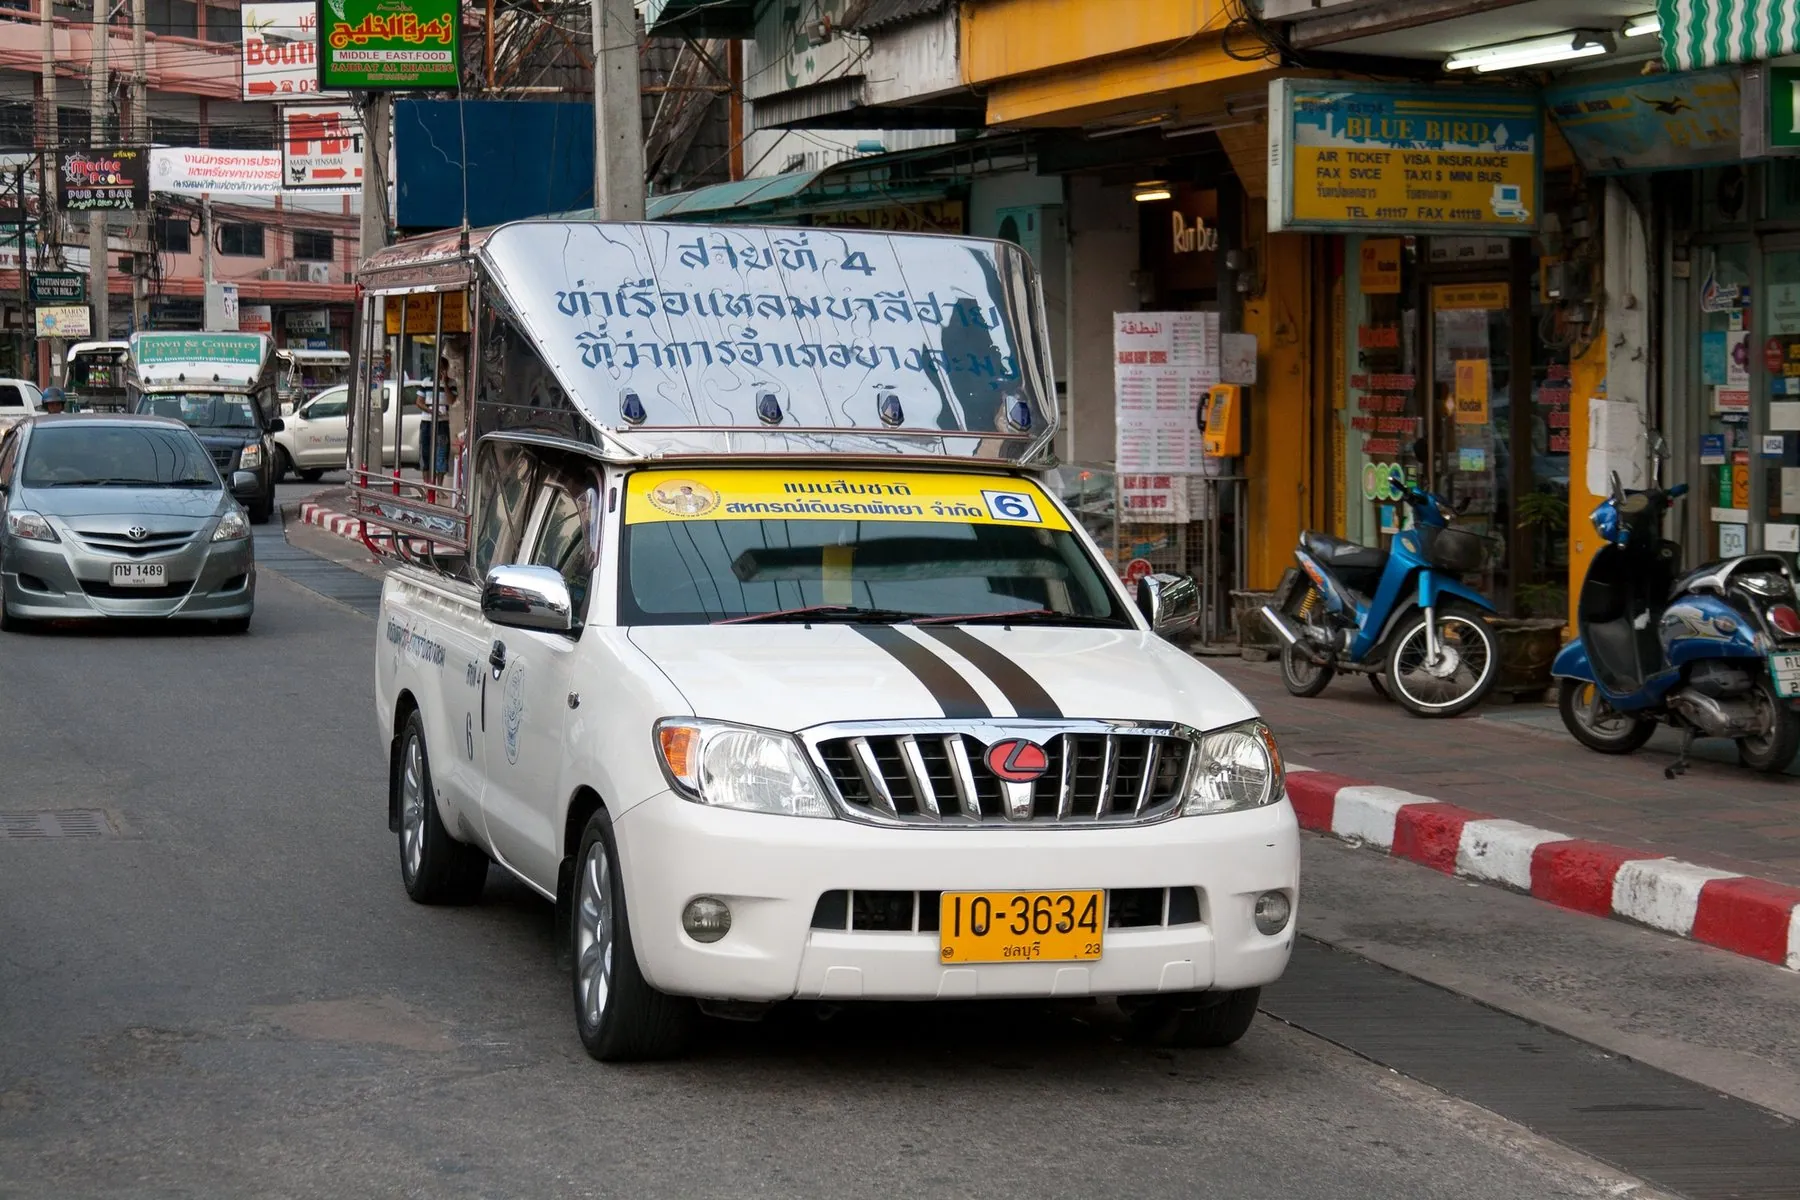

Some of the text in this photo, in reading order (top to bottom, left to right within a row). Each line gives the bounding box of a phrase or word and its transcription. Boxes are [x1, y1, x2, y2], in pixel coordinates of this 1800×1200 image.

[339, 51, 380, 60] MIDDLE
[331, 64, 379, 72] ZAHRAT
[382, 64, 397, 72] AL
[1346, 117, 1490, 143] BLUE BIRD
[1316, 152, 1508, 167] AIR TICKET VISA INSURANCE
[71, 157, 121, 176] Marine
[1316, 168, 1341, 179] FAX
[1350, 169, 1382, 180] SVCE
[1404, 170, 1432, 181] TAXI
[1449, 172, 1473, 182] MINI
[1477, 172, 1502, 182] BUS
[68, 189, 132, 199] PUB & BAR
[1346, 207, 1368, 218] TEL
[1417, 208, 1443, 220] FAX
[678, 233, 876, 277] สายที่ 4
[76, 276, 81, 287] 2
[37, 287, 51, 295] ROCK
[60, 287, 73, 296] ROLL
[202, 340, 257, 350] Country
[1458, 400, 1482, 411] Kodak
[1766, 440, 1783, 449] VISA
[726, 499, 923, 516] สหกรณ์เดินรถพัทยา
[930, 502, 983, 517] จำกัด
[994, 496, 1029, 517] 6
[136, 565, 163, 576] 1489
[466, 711, 474, 761] 6
[953, 894, 1098, 937] 10-3634
[1002, 941, 1041, 959] ชลบุรี
[1084, 943, 1101, 955] 23
